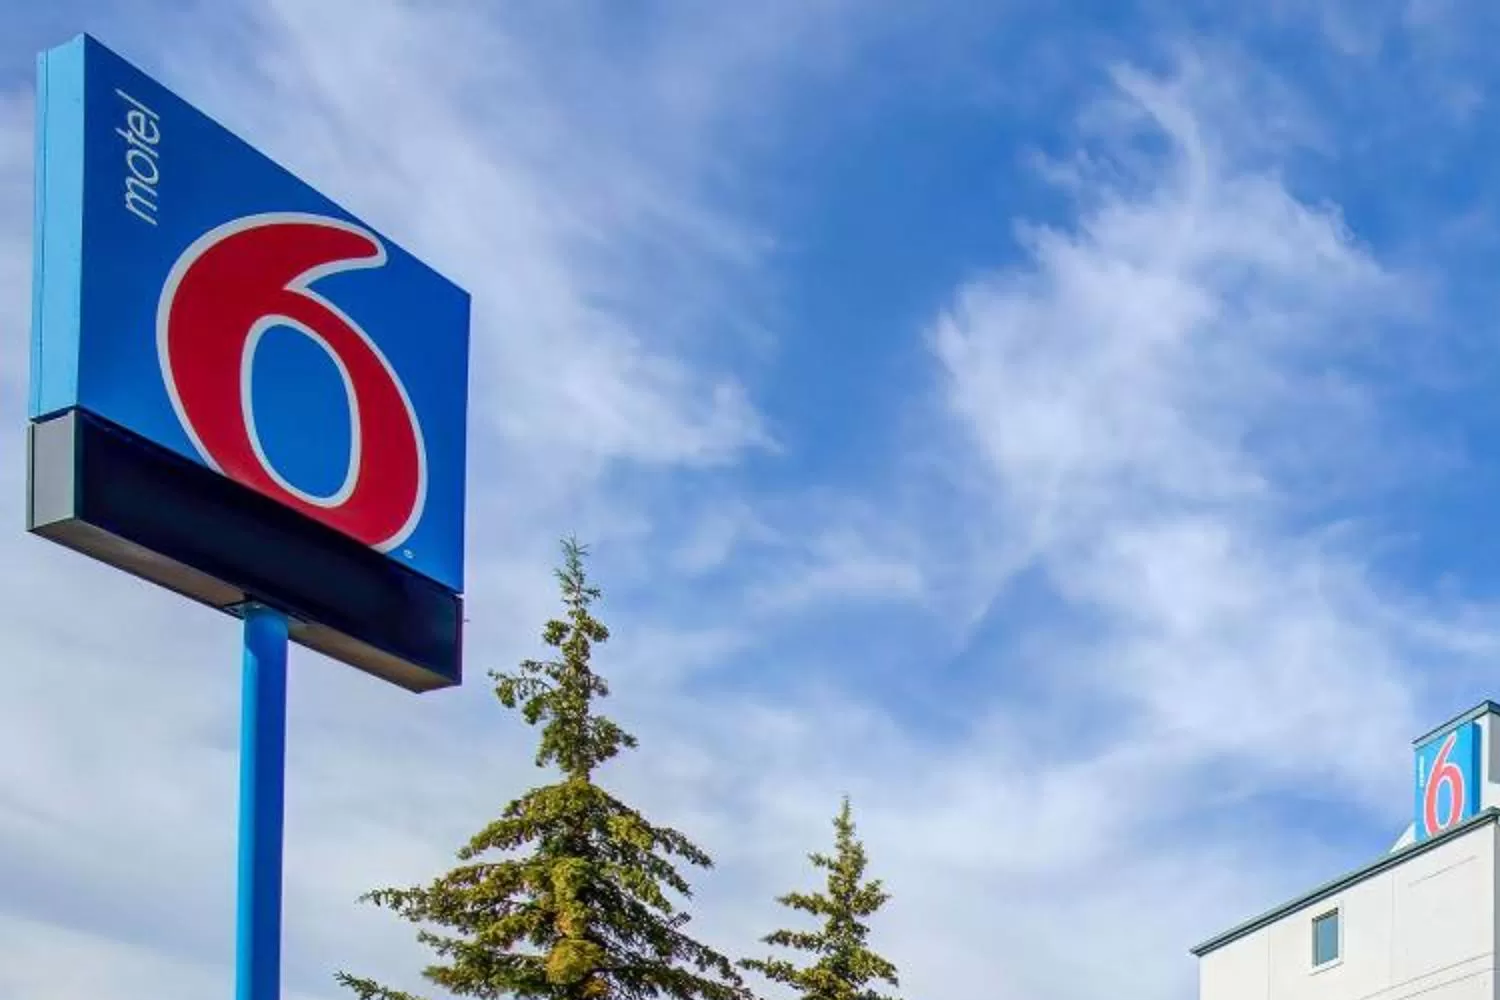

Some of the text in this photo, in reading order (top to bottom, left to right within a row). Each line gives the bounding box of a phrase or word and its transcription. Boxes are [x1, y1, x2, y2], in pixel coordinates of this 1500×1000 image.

[115, 88, 161, 226] motel
[155, 211, 427, 553] 6
[1424, 730, 1465, 837] 6
